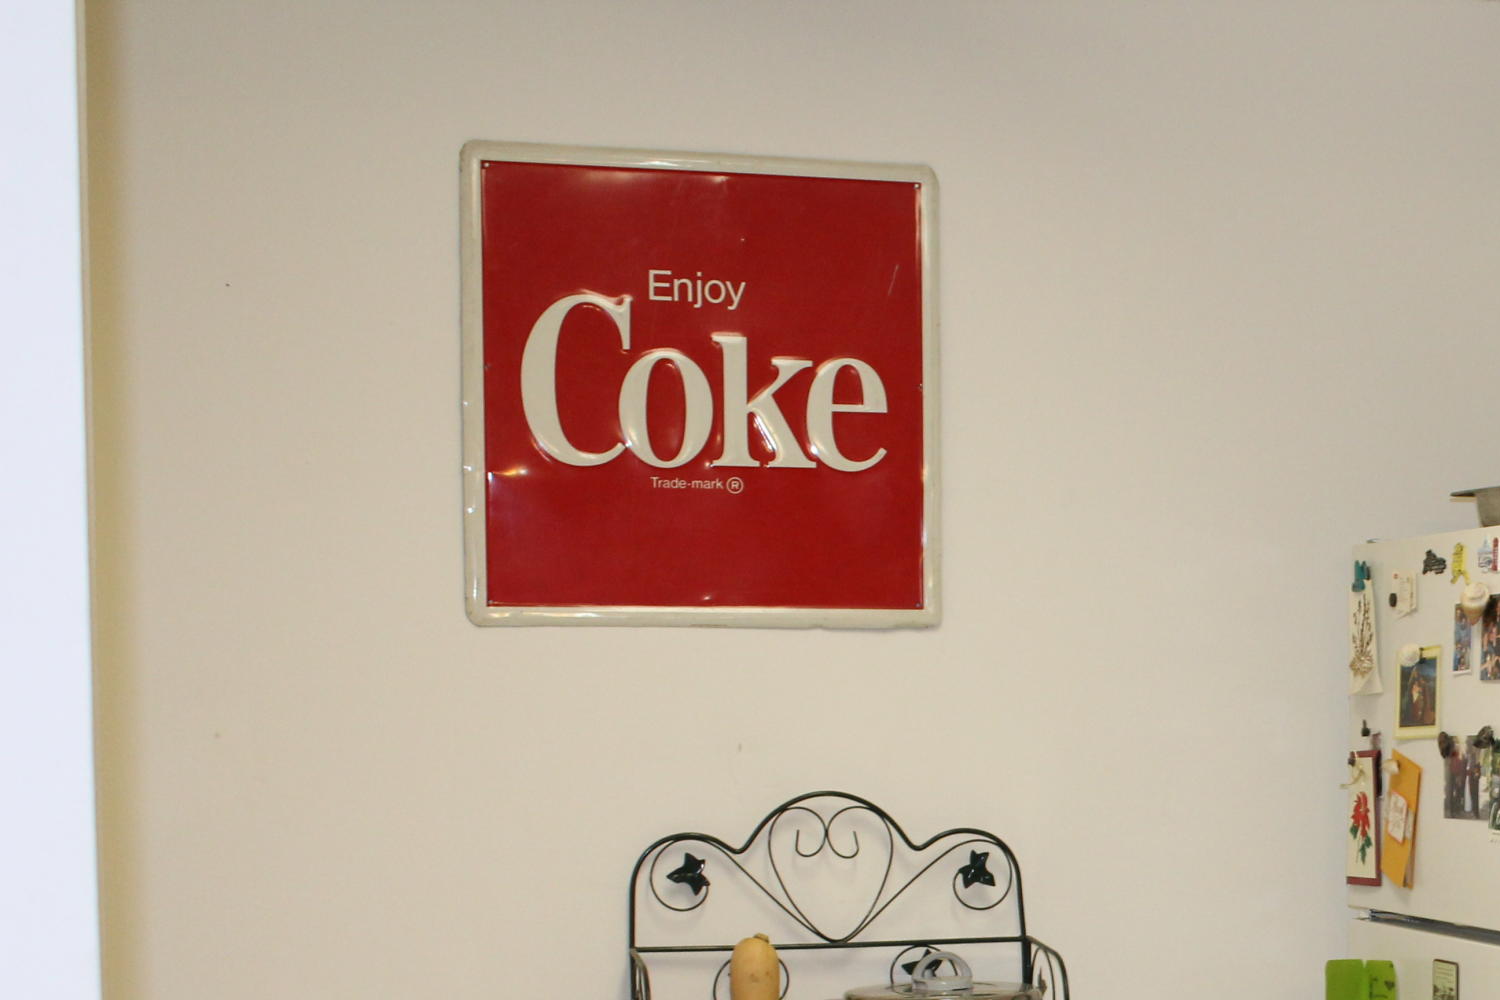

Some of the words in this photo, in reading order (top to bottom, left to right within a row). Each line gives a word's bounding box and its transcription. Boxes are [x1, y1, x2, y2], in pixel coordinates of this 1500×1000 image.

[648, 269, 746, 310] Enjoy
[520, 292, 888, 473] Coke
[650, 476, 724, 489] Trade-mark
